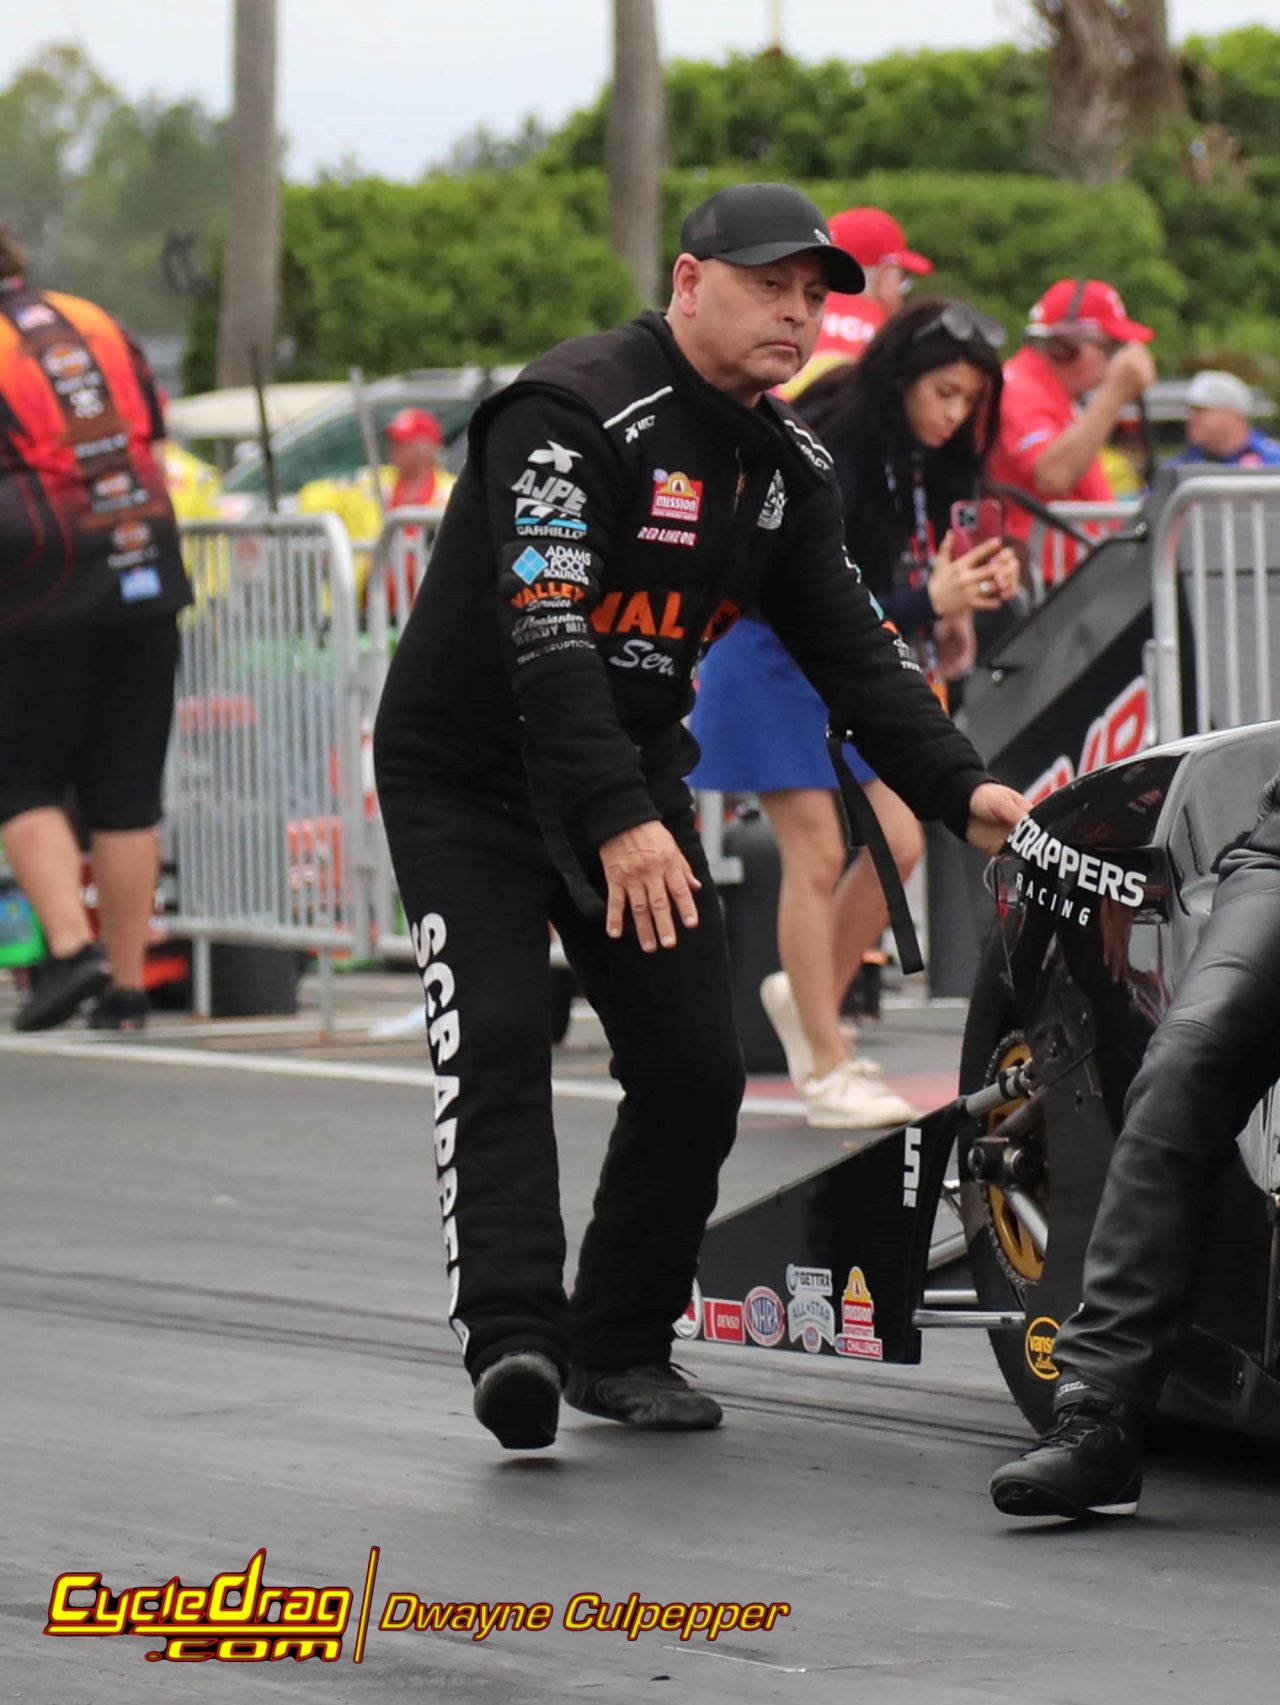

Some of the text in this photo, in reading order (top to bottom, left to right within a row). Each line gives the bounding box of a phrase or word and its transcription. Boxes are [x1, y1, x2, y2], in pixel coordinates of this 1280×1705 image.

[511, 468, 588, 512] AJPE
[545, 545, 592, 567] ADAMS
[1007, 815, 1147, 908] SCRAPPERS
[1014, 872, 1091, 926] RACING
[750, 1297, 779, 1335] NHRA
